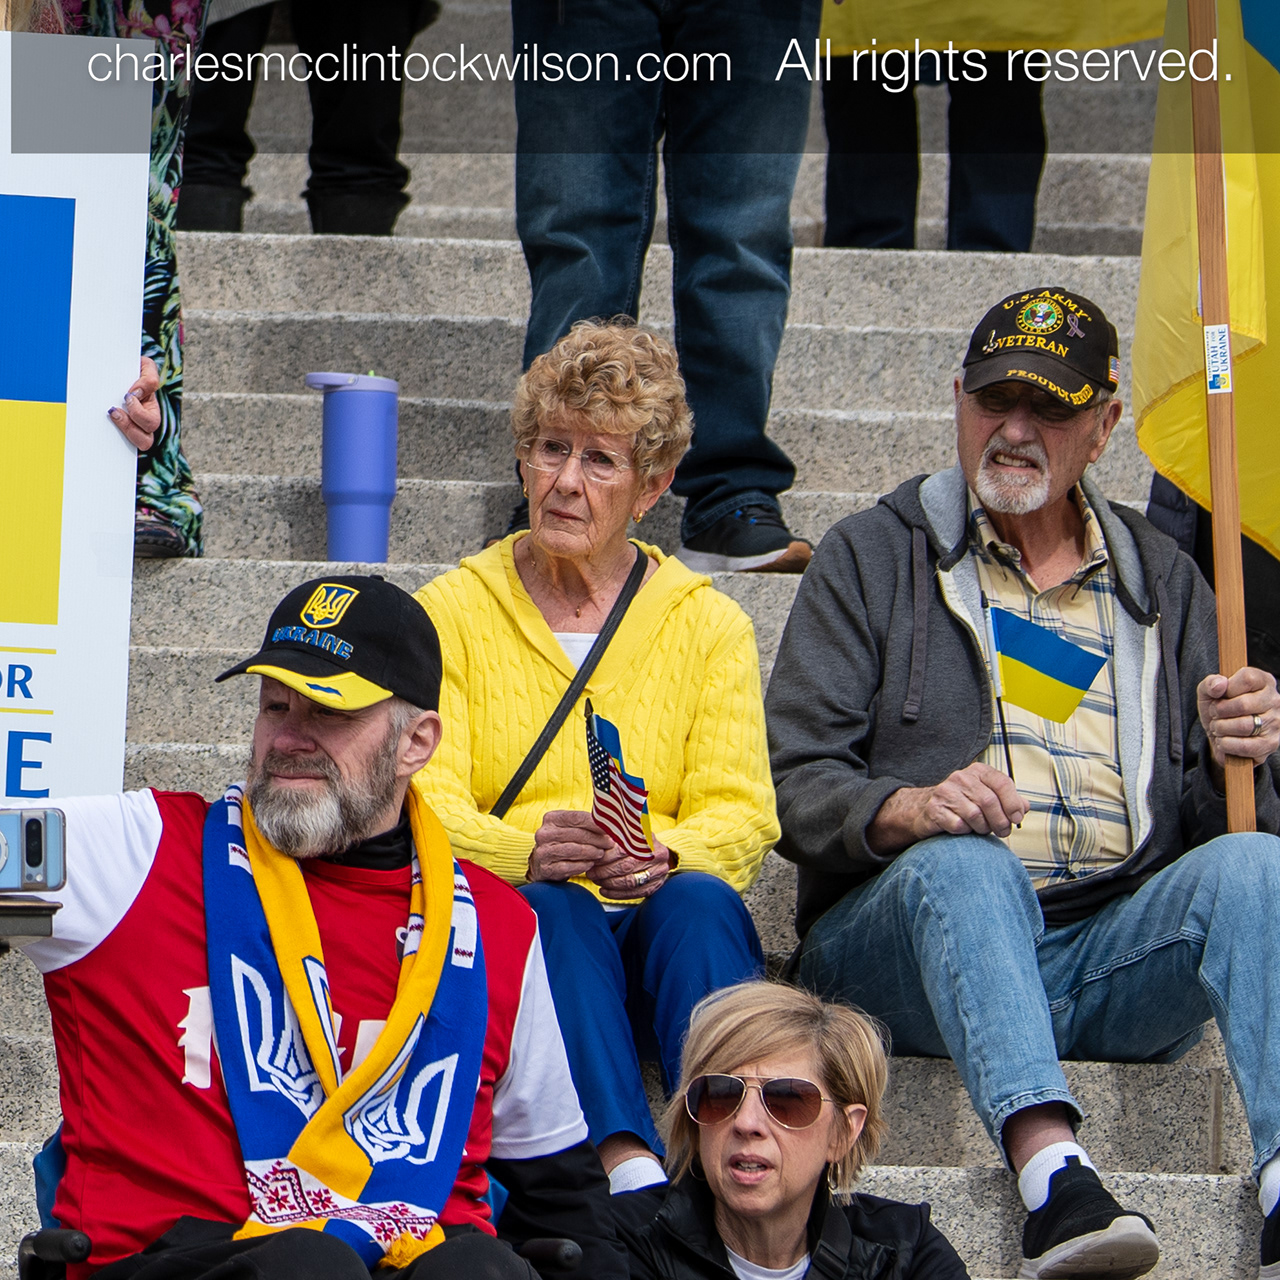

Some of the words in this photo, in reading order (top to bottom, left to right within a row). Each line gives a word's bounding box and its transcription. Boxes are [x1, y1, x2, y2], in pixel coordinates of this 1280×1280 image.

[1002, 293, 1035, 311] U.S.
[996, 334, 1070, 359] VETERAN
[1210, 345, 1220, 373] UTAH
[1218, 328, 1229, 372] UKRAINE
[272, 625, 355, 660] UKRAINE
